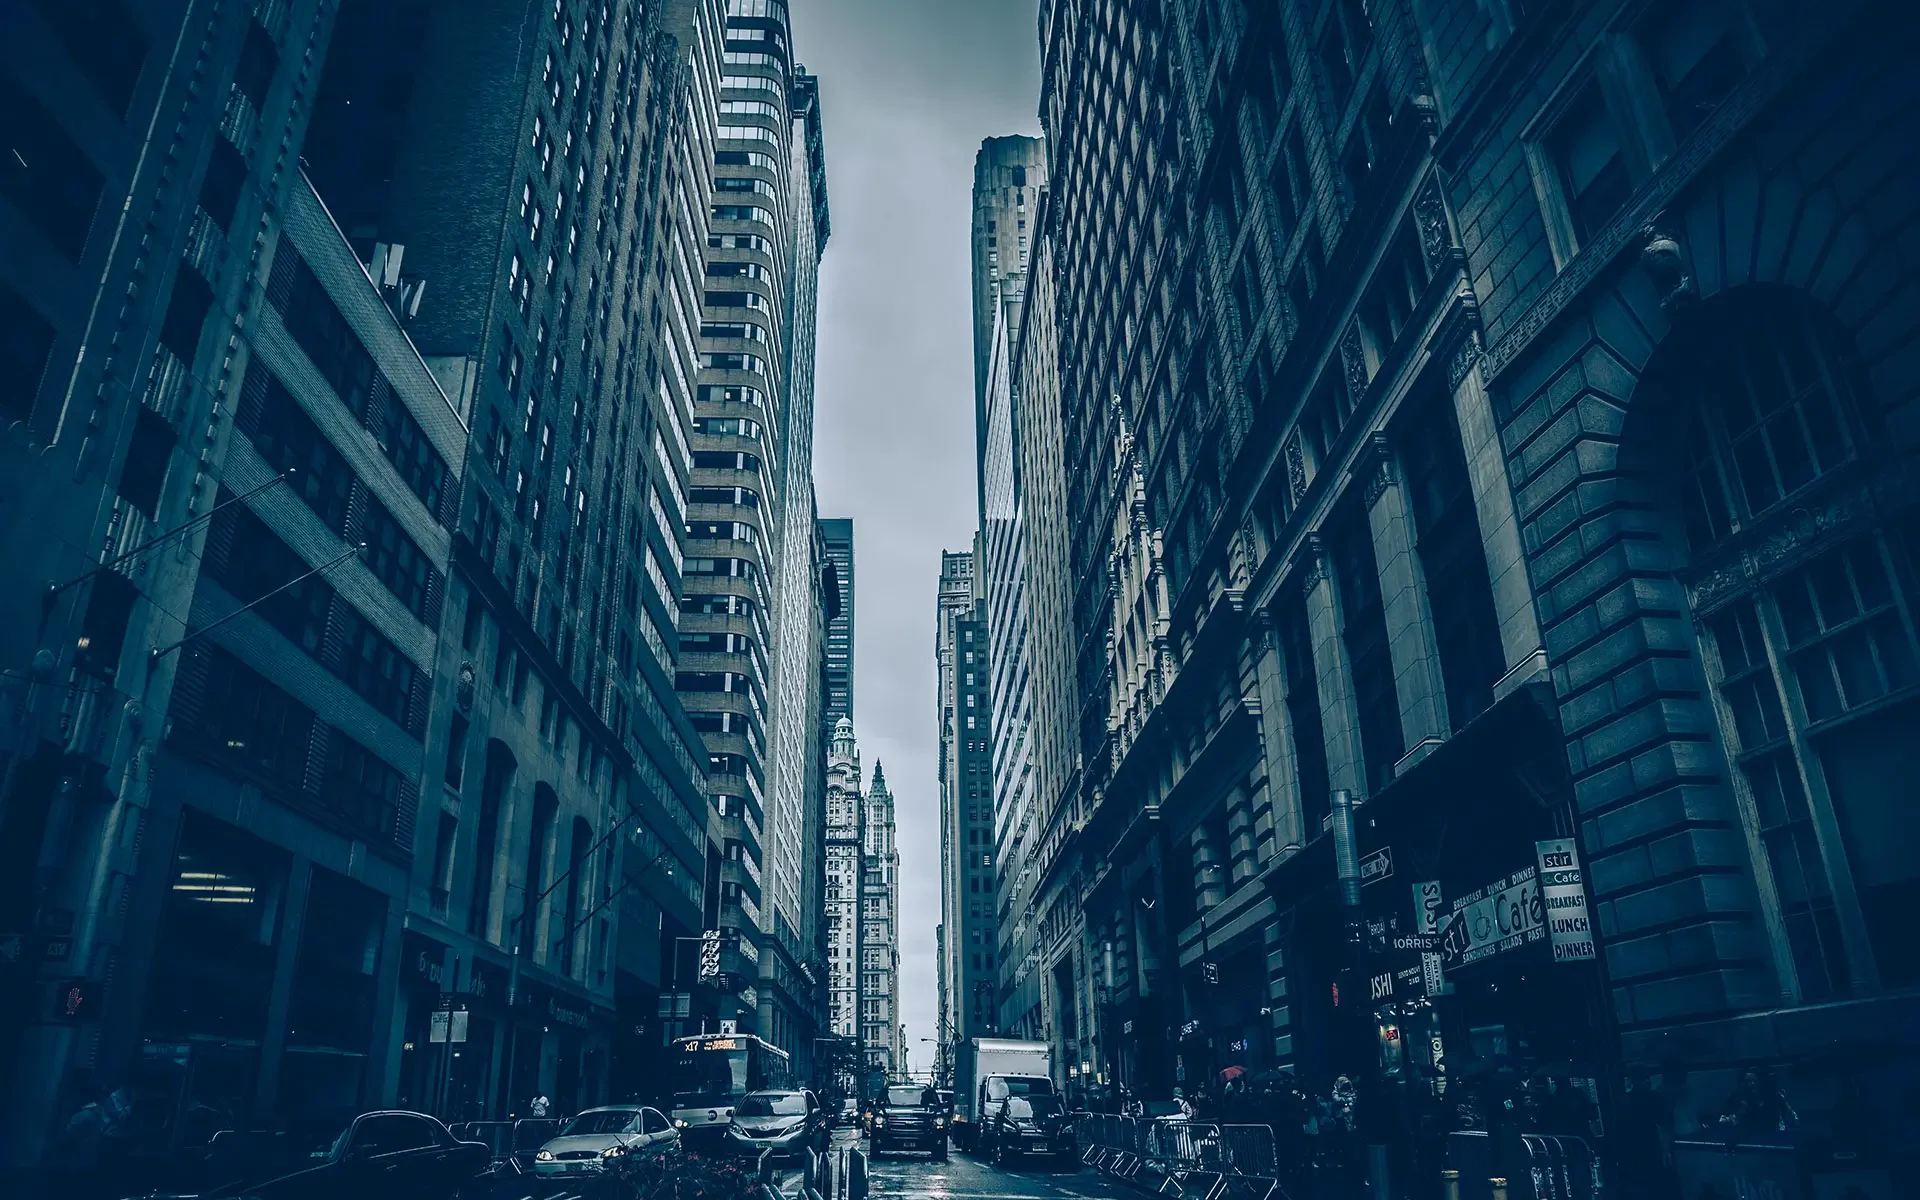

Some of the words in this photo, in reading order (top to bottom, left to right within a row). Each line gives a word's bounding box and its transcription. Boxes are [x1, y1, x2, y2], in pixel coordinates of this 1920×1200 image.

[1546, 852, 1569, 867] stir
[1554, 872, 1580, 883] Café
[1453, 889, 1482, 910] BREAKFAST
[1487, 879, 1506, 895] LUNCH
[1512, 866, 1535, 885] DINNER
[1546, 895, 1585, 910] BREAKFAST
[1496, 886, 1543, 936] Café
[1552, 918, 1588, 934] LUNCH
[1463, 944, 1496, 964] SANDWICHES
[1500, 934, 1523, 952] SALADS
[1554, 941, 1594, 958] DINNER
